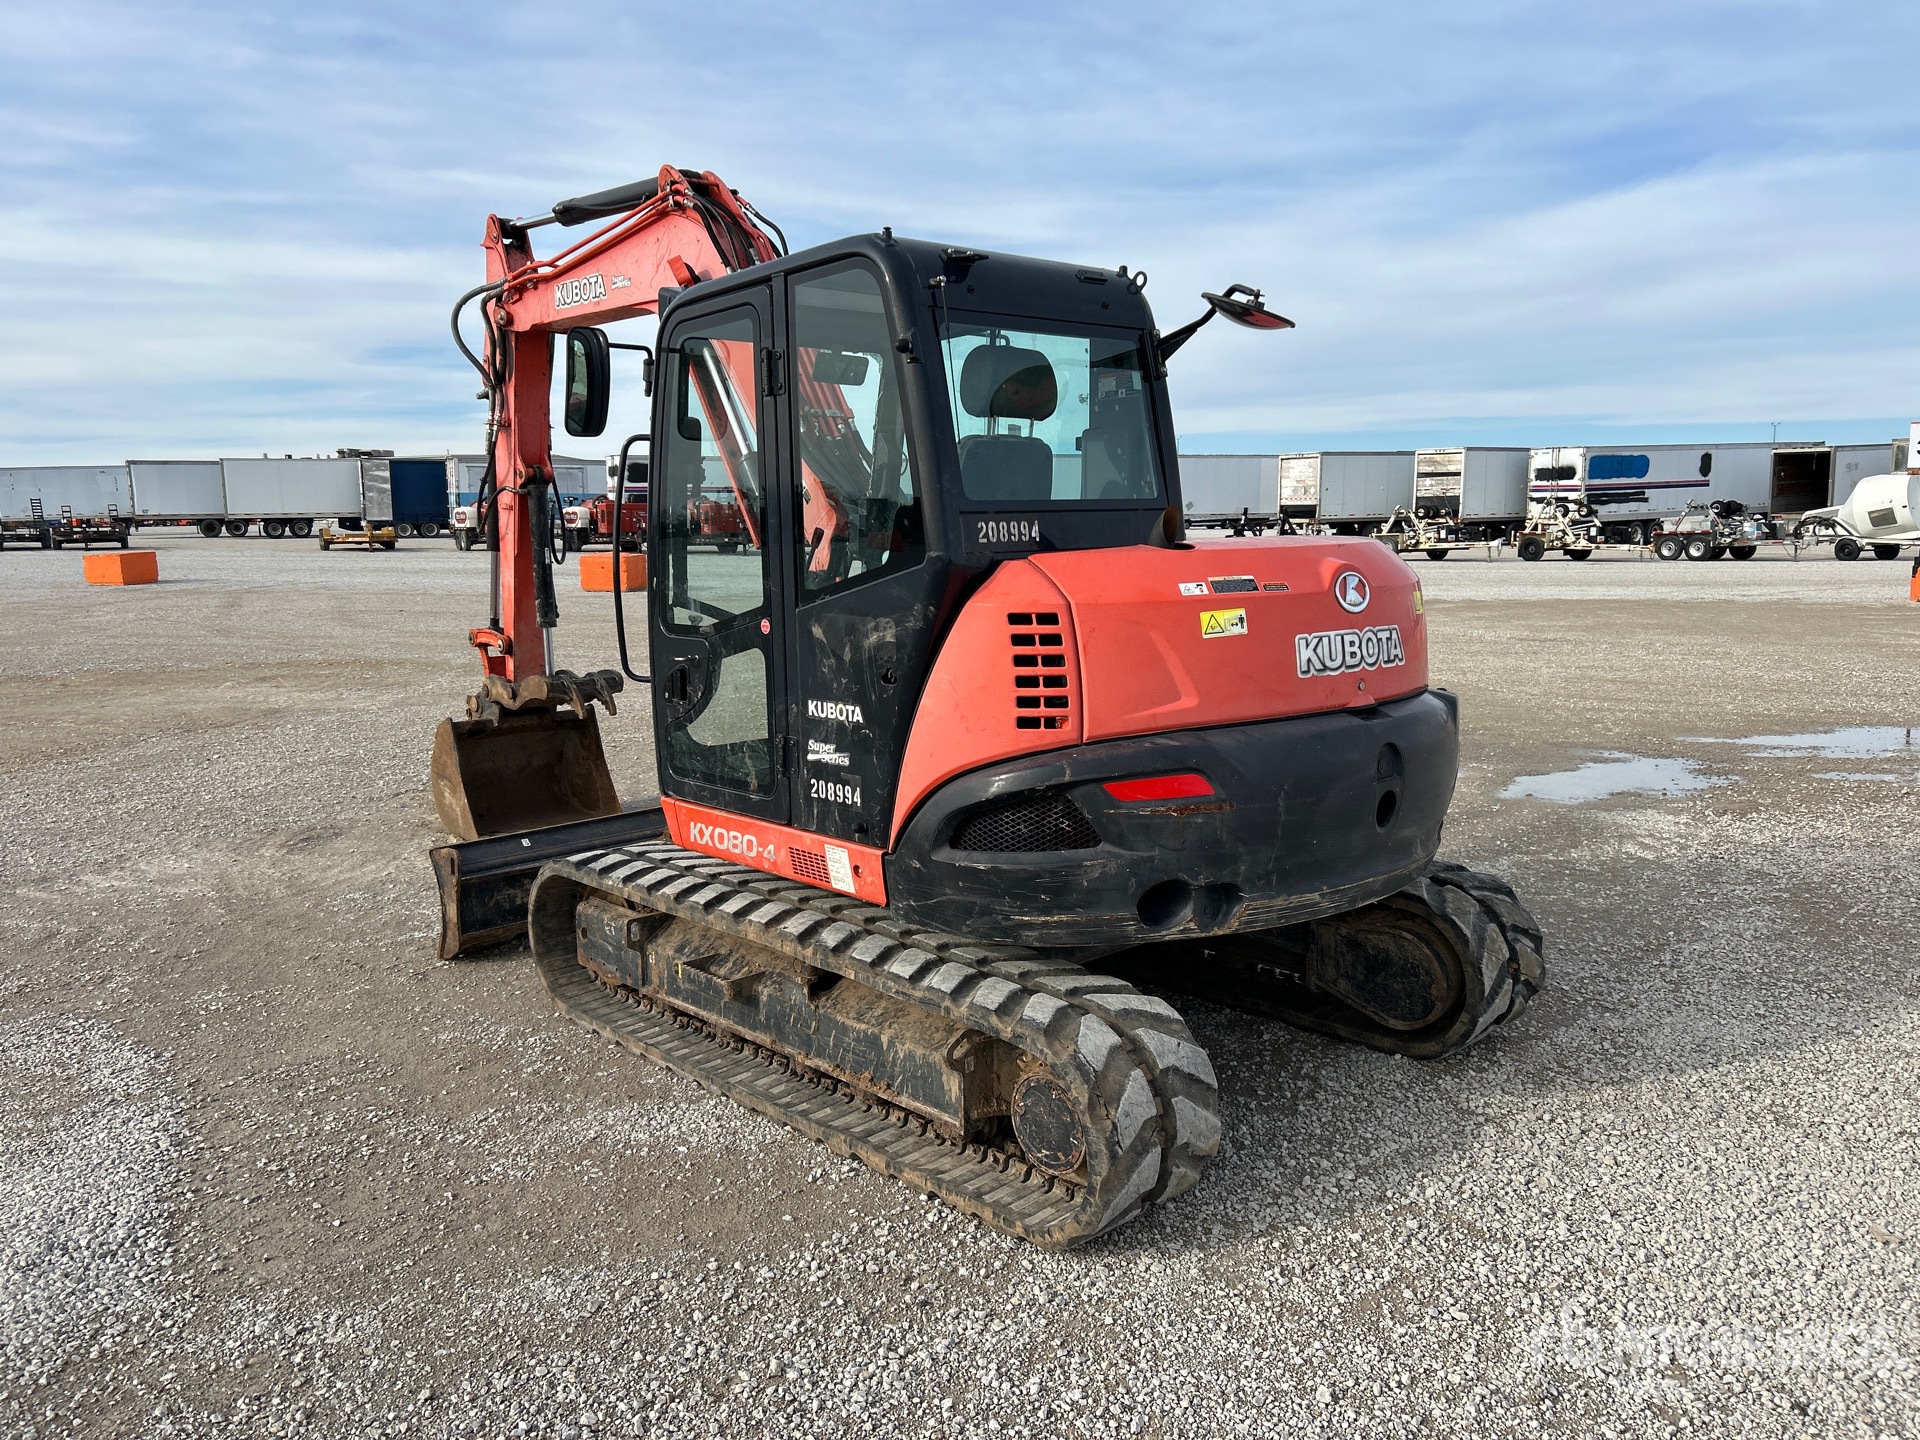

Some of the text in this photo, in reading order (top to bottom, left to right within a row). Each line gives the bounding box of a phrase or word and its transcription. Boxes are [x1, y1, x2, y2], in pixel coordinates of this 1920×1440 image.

[555, 273, 607, 308] KUBOTA
[977, 520, 1040, 544] 208994
[1297, 627, 1404, 676] KUBOTA
[808, 699, 863, 724] KUBOTA
[808, 739, 836, 754] Super
[820, 752, 850, 766] Series
[810, 778, 861, 807] 208994
[690, 820, 776, 863] KX080-4
